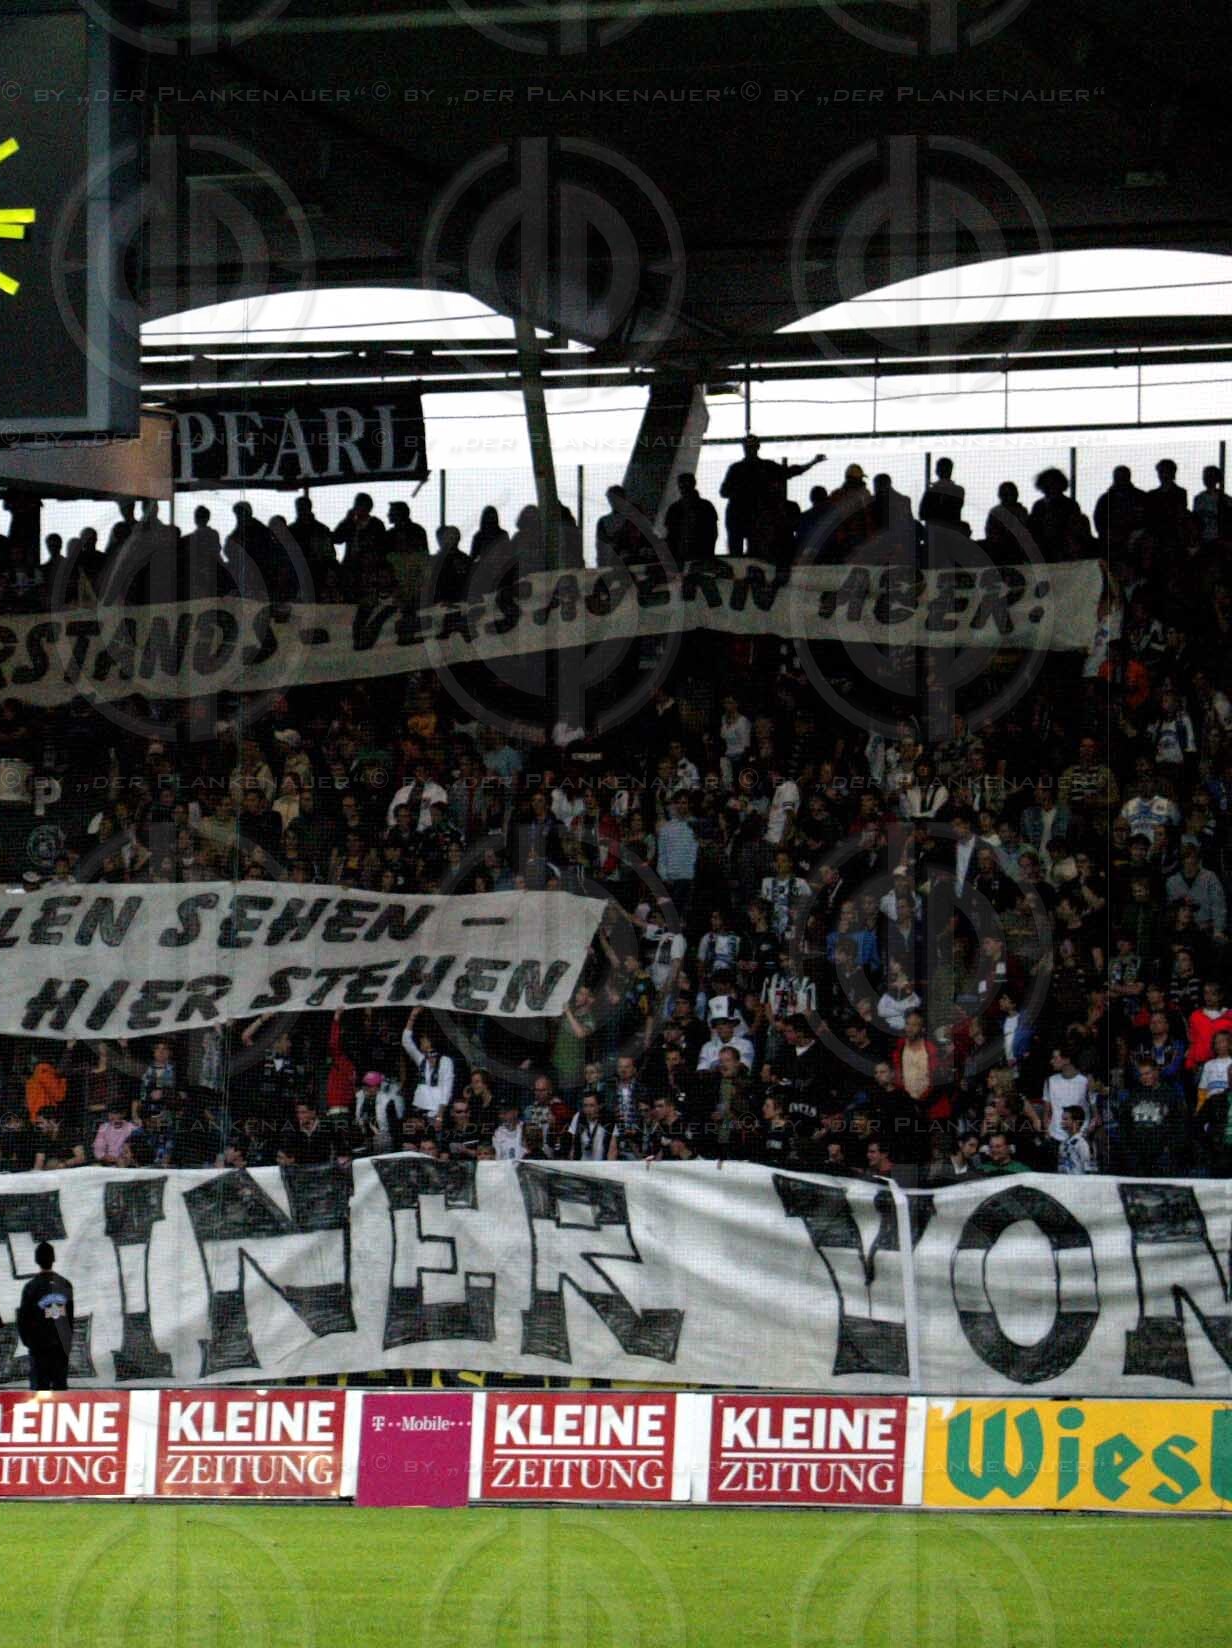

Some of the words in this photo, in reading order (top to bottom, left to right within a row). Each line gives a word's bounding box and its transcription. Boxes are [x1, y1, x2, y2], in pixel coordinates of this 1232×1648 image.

[175, 404, 419, 483] PEARL
[158, 890, 435, 950] SEHEN
[22, 973, 234, 1033] HIER
[252, 954, 572, 1013] STEHEN
[173, 1399, 336, 1443] KLEINE
[494, 1404, 664, 1447] KLEINE
[722, 1407, 897, 1450] KLEINE
[166, 1452, 335, 1488] ZEITUNG
[491, 1458, 666, 1491] ZEITUNG
[718, 1461, 896, 1494] ZEITUNG
